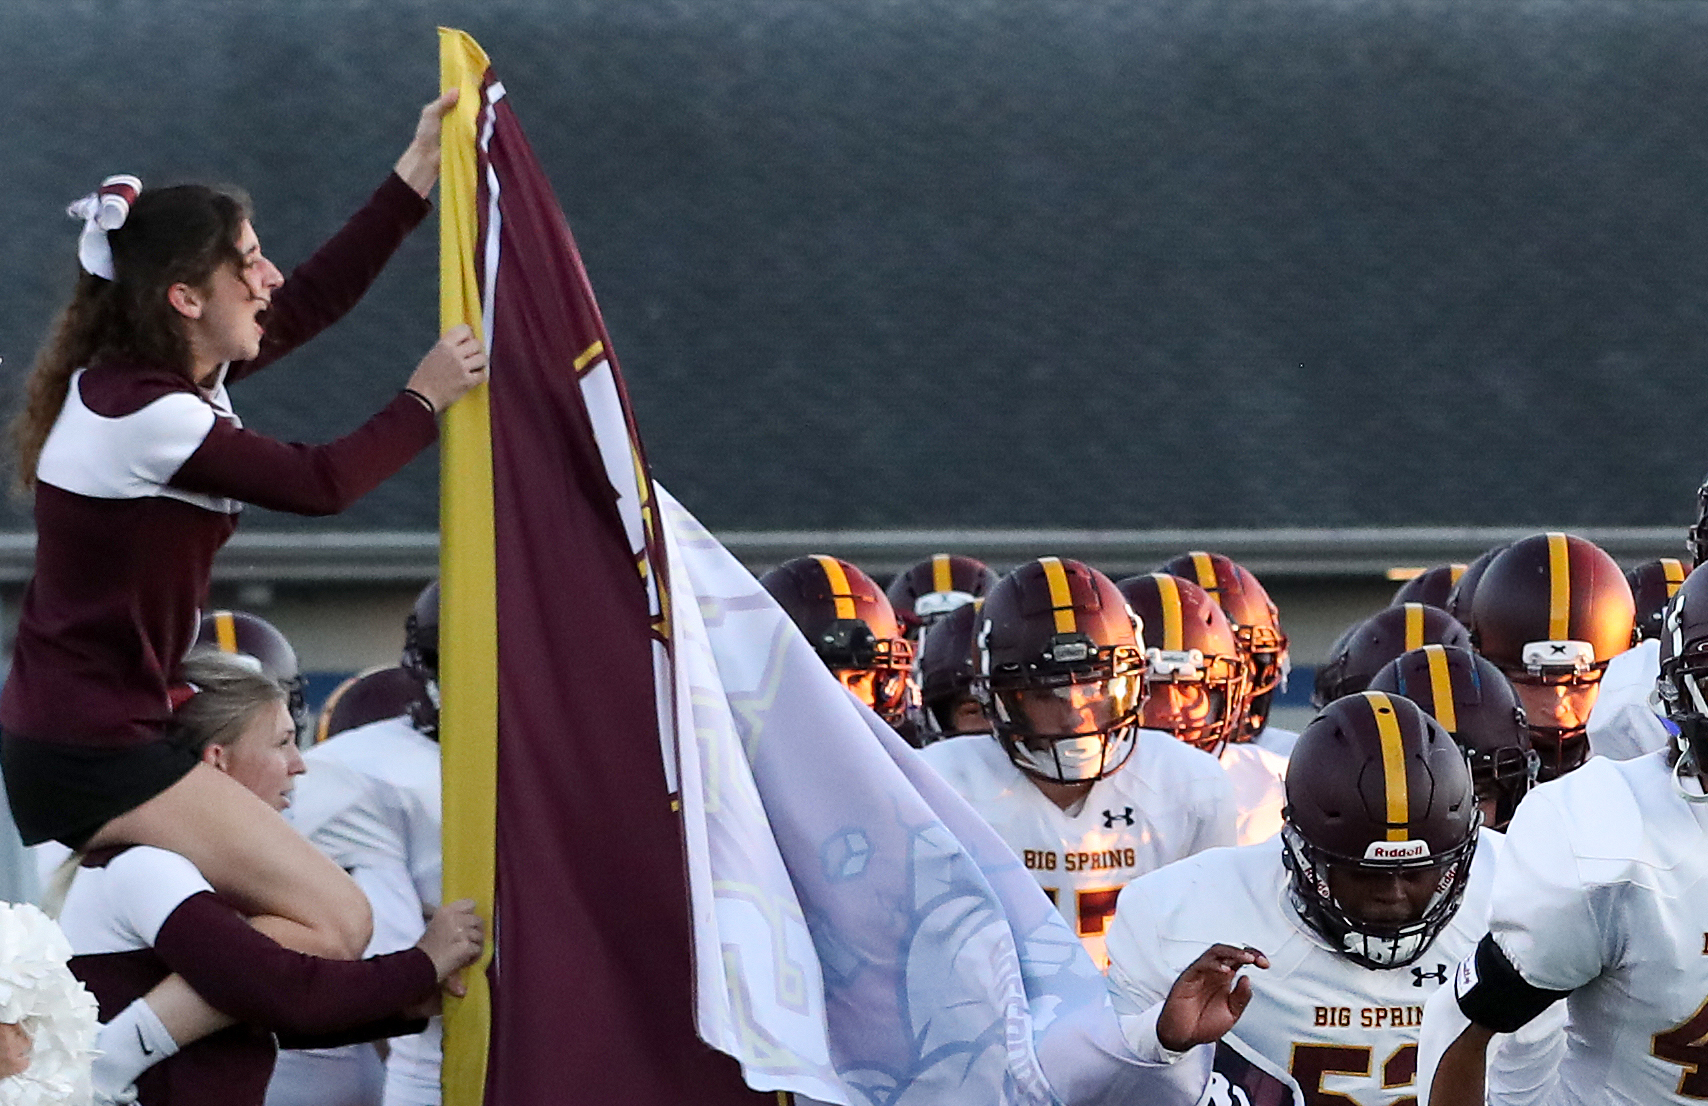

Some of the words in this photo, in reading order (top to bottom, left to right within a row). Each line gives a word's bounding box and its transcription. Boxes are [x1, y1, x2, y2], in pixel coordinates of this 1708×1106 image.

[1023, 849, 1057, 871] BIG
[1064, 847, 1135, 872] SPRING
[1374, 845, 1423, 858] Riddell
[1314, 1006, 1351, 1027] BIG
